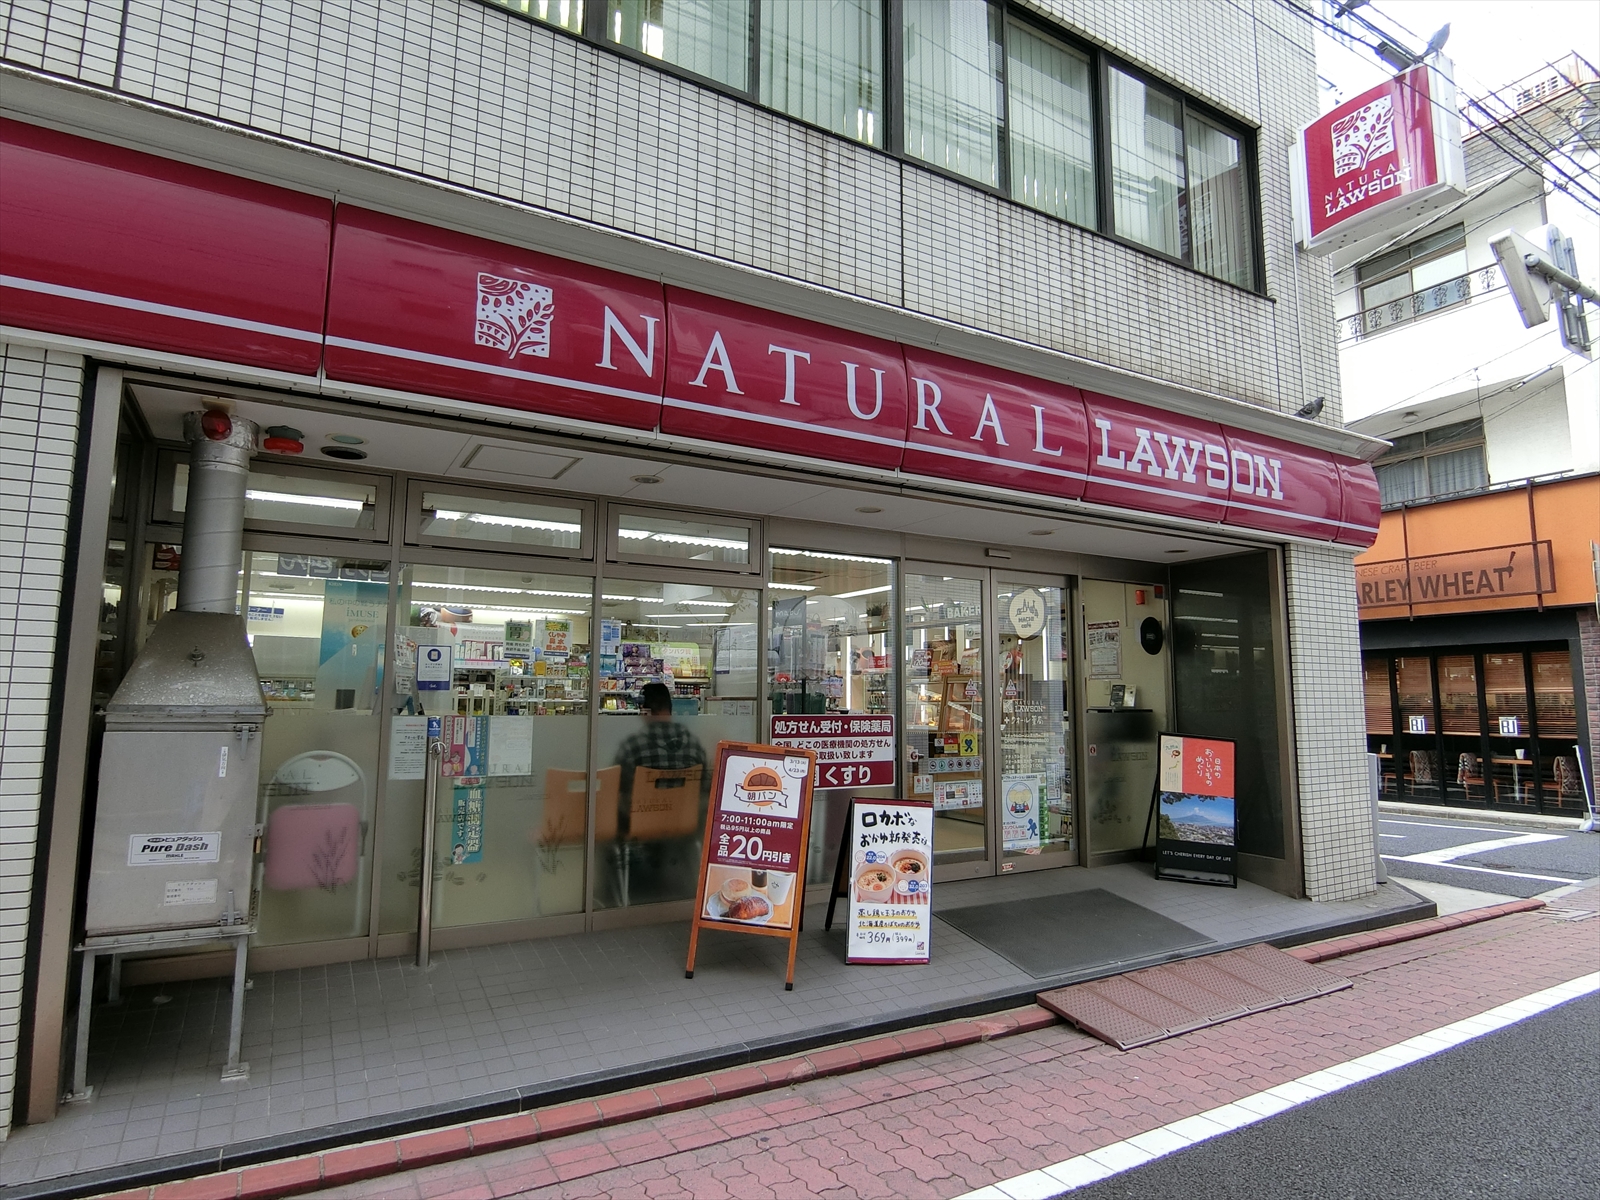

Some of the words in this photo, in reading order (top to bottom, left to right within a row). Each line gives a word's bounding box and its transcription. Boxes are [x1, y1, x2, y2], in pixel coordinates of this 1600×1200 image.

[1324, 158, 1412, 203] NATURAL
[1325, 168, 1413, 217] LAWSON
[595, 305, 1063, 457] NATURAL
[1095, 418, 1284, 501] LAWSON
[1414, 560, 1438, 571] BEER
[1417, 567, 1508, 599] WHEAT
[346, 607, 379, 619] iMUSE
[774, 720, 891, 734] 処方せん受付・保険薬局
[1195, 756, 1205, 777] めぐり
[1205, 748, 1214, 787] おいしいもの
[1213, 758, 1222, 779] 日本の
[747, 791, 778, 801] 朝パン
[467, 788, 483, 852] 血糖測定器
[721, 814, 794, 830] 7:00-11:00am限定
[861, 809, 918, 828] ロカボな
[141, 844, 173, 853] Pure
[175, 842, 209, 852] Dash
